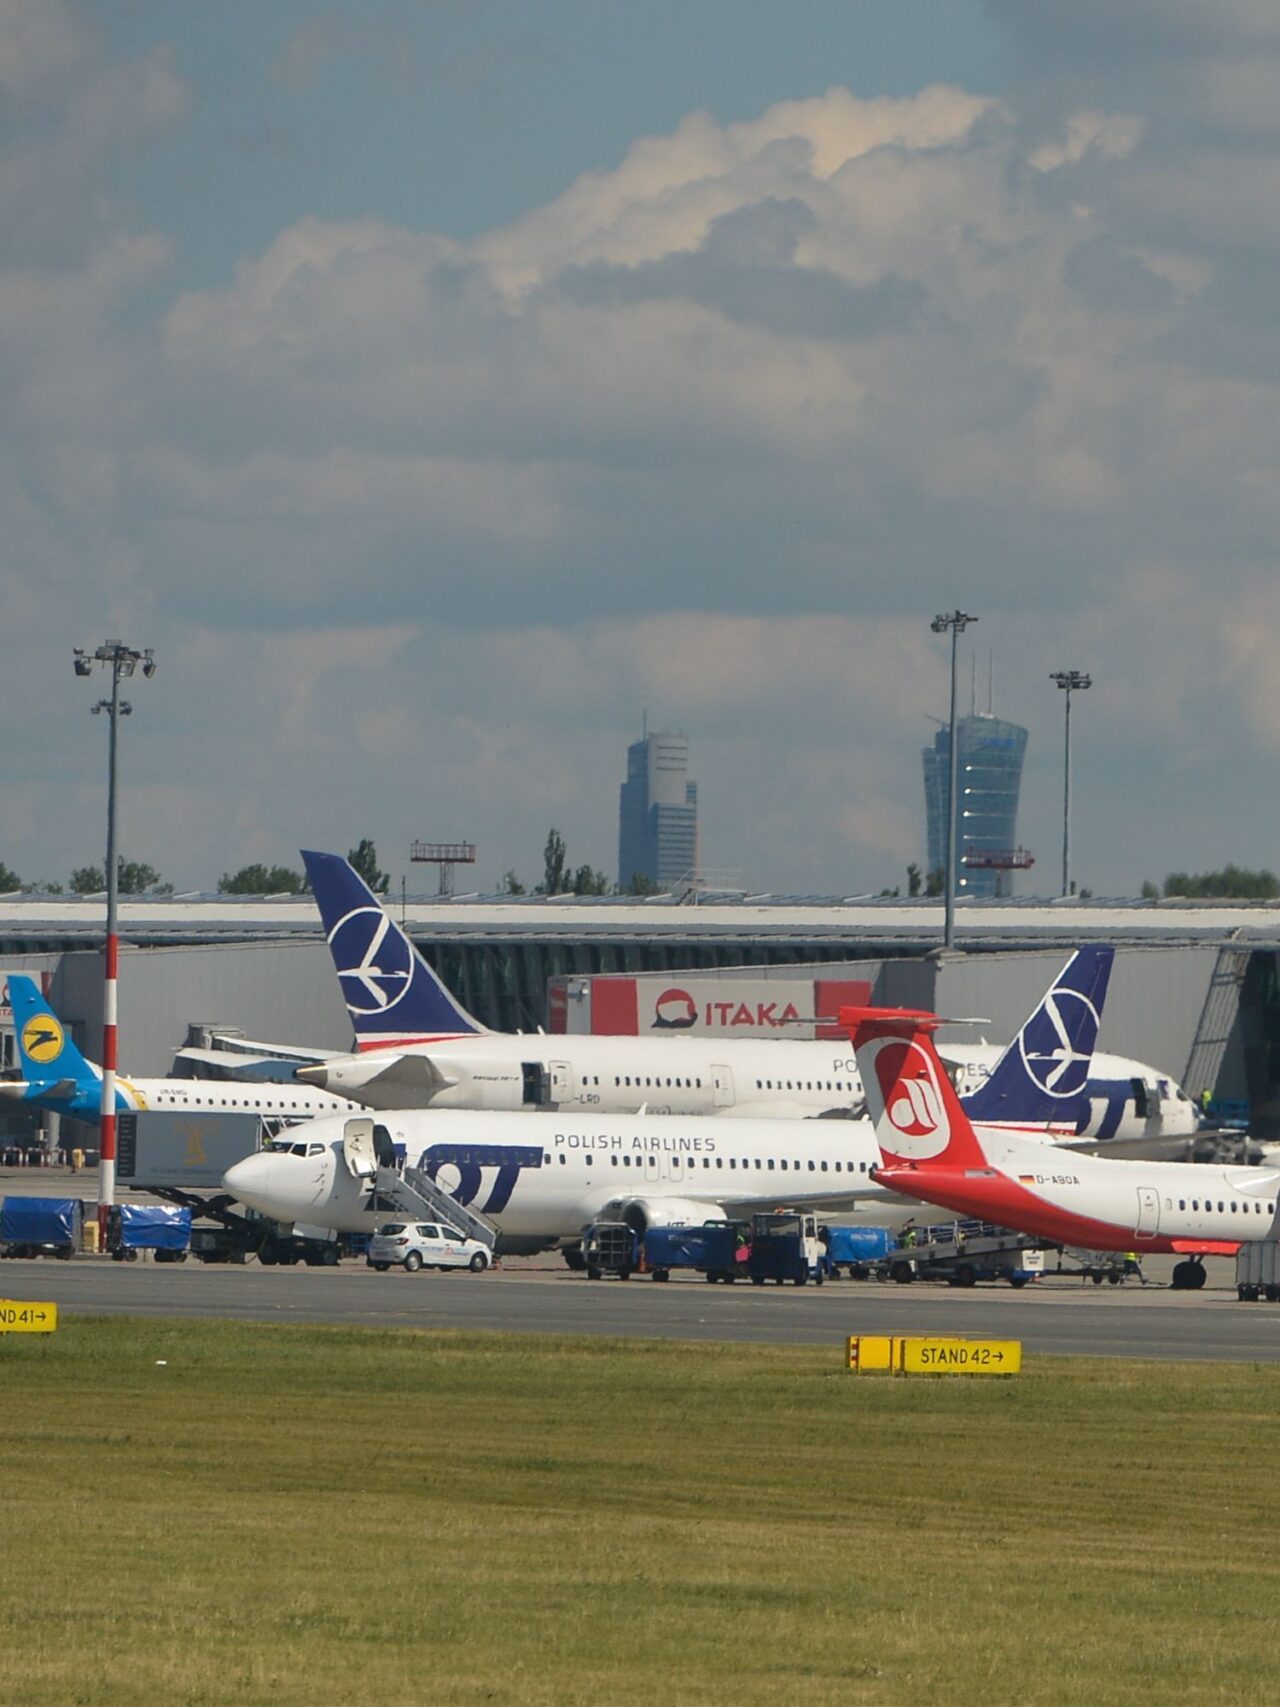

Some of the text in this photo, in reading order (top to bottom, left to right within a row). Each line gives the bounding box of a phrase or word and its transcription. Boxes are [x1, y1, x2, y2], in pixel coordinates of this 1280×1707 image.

[705, 1002, 803, 1027] ITAKA
[554, 1134, 716, 1152] POLISH AIRLINES
[18, 1309, 34, 1324] 41
[920, 1348, 990, 1365] STAND 42
